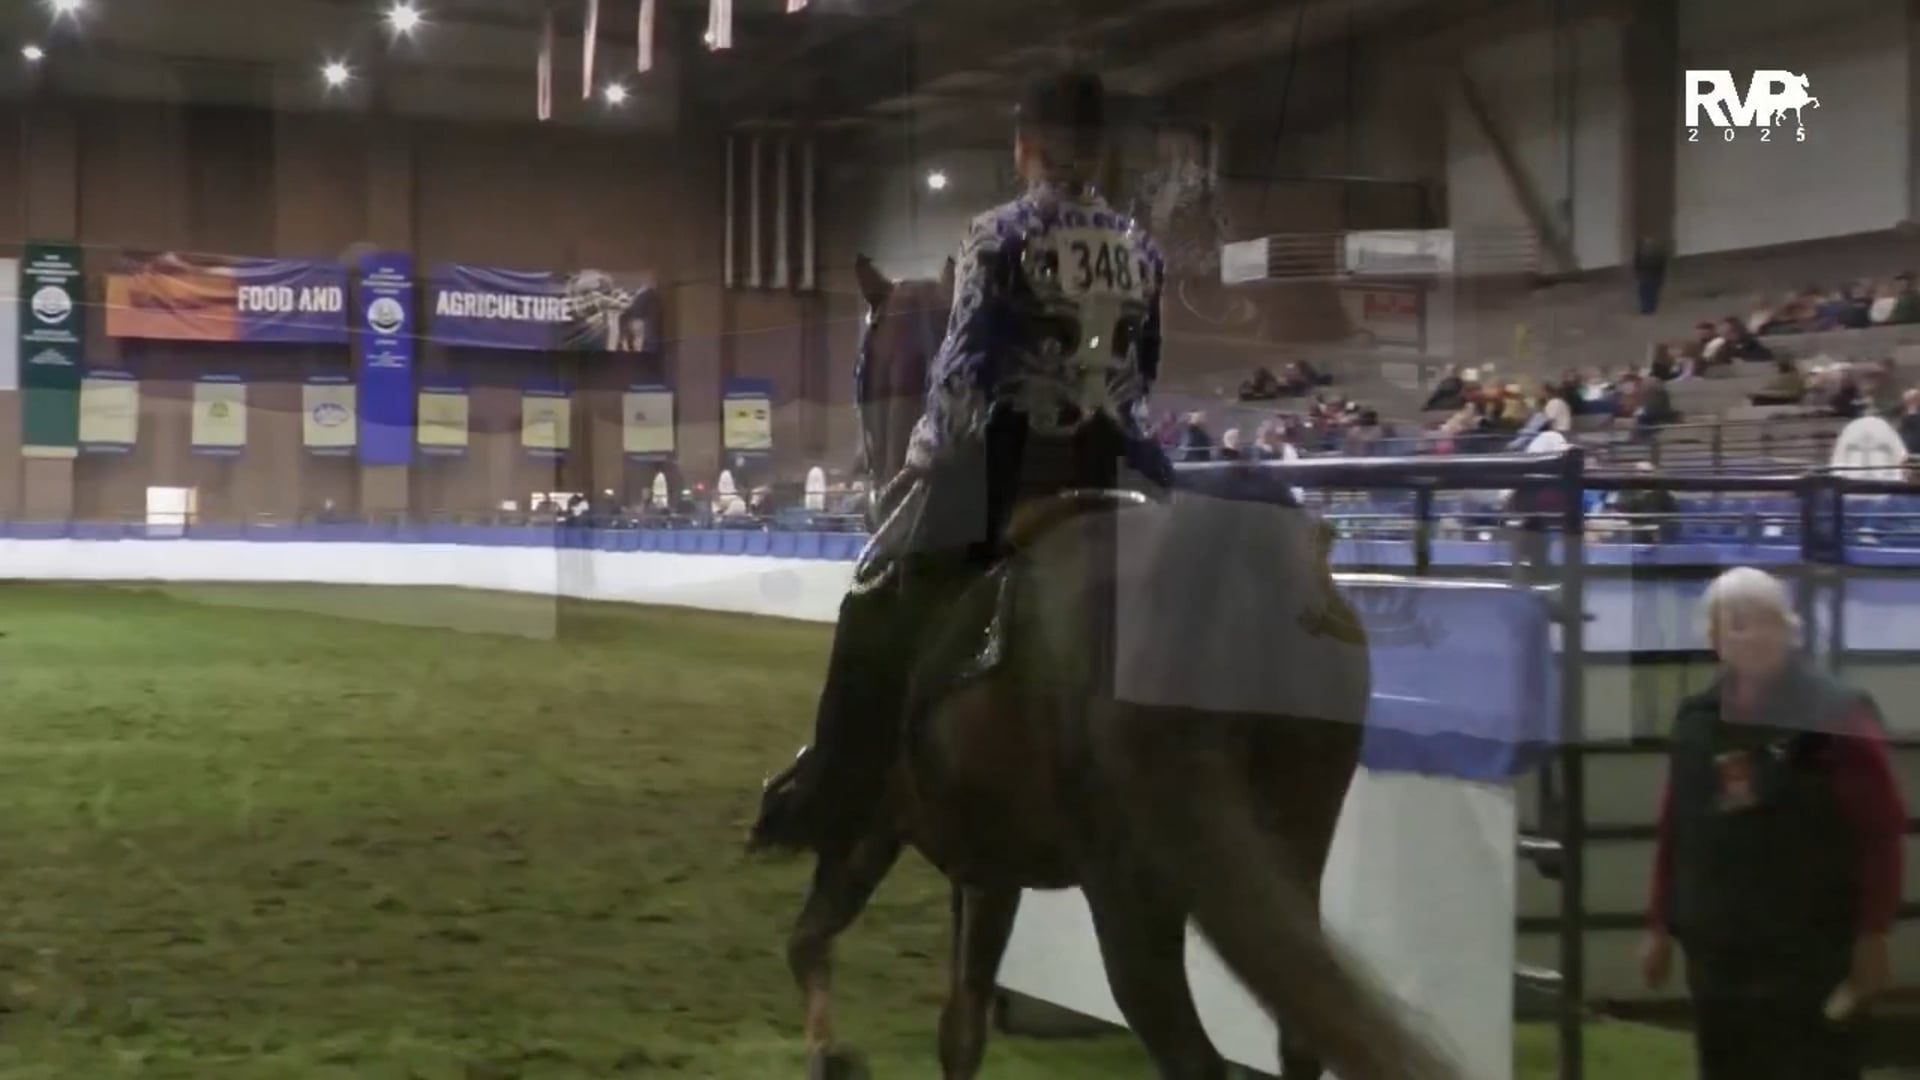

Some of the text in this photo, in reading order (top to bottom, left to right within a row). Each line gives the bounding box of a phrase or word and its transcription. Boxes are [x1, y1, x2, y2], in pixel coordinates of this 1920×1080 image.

[1070, 241, 1132, 291] 348
[238, 285, 342, 312] FOOD AND
[435, 290, 574, 321] AGRICULTURE
